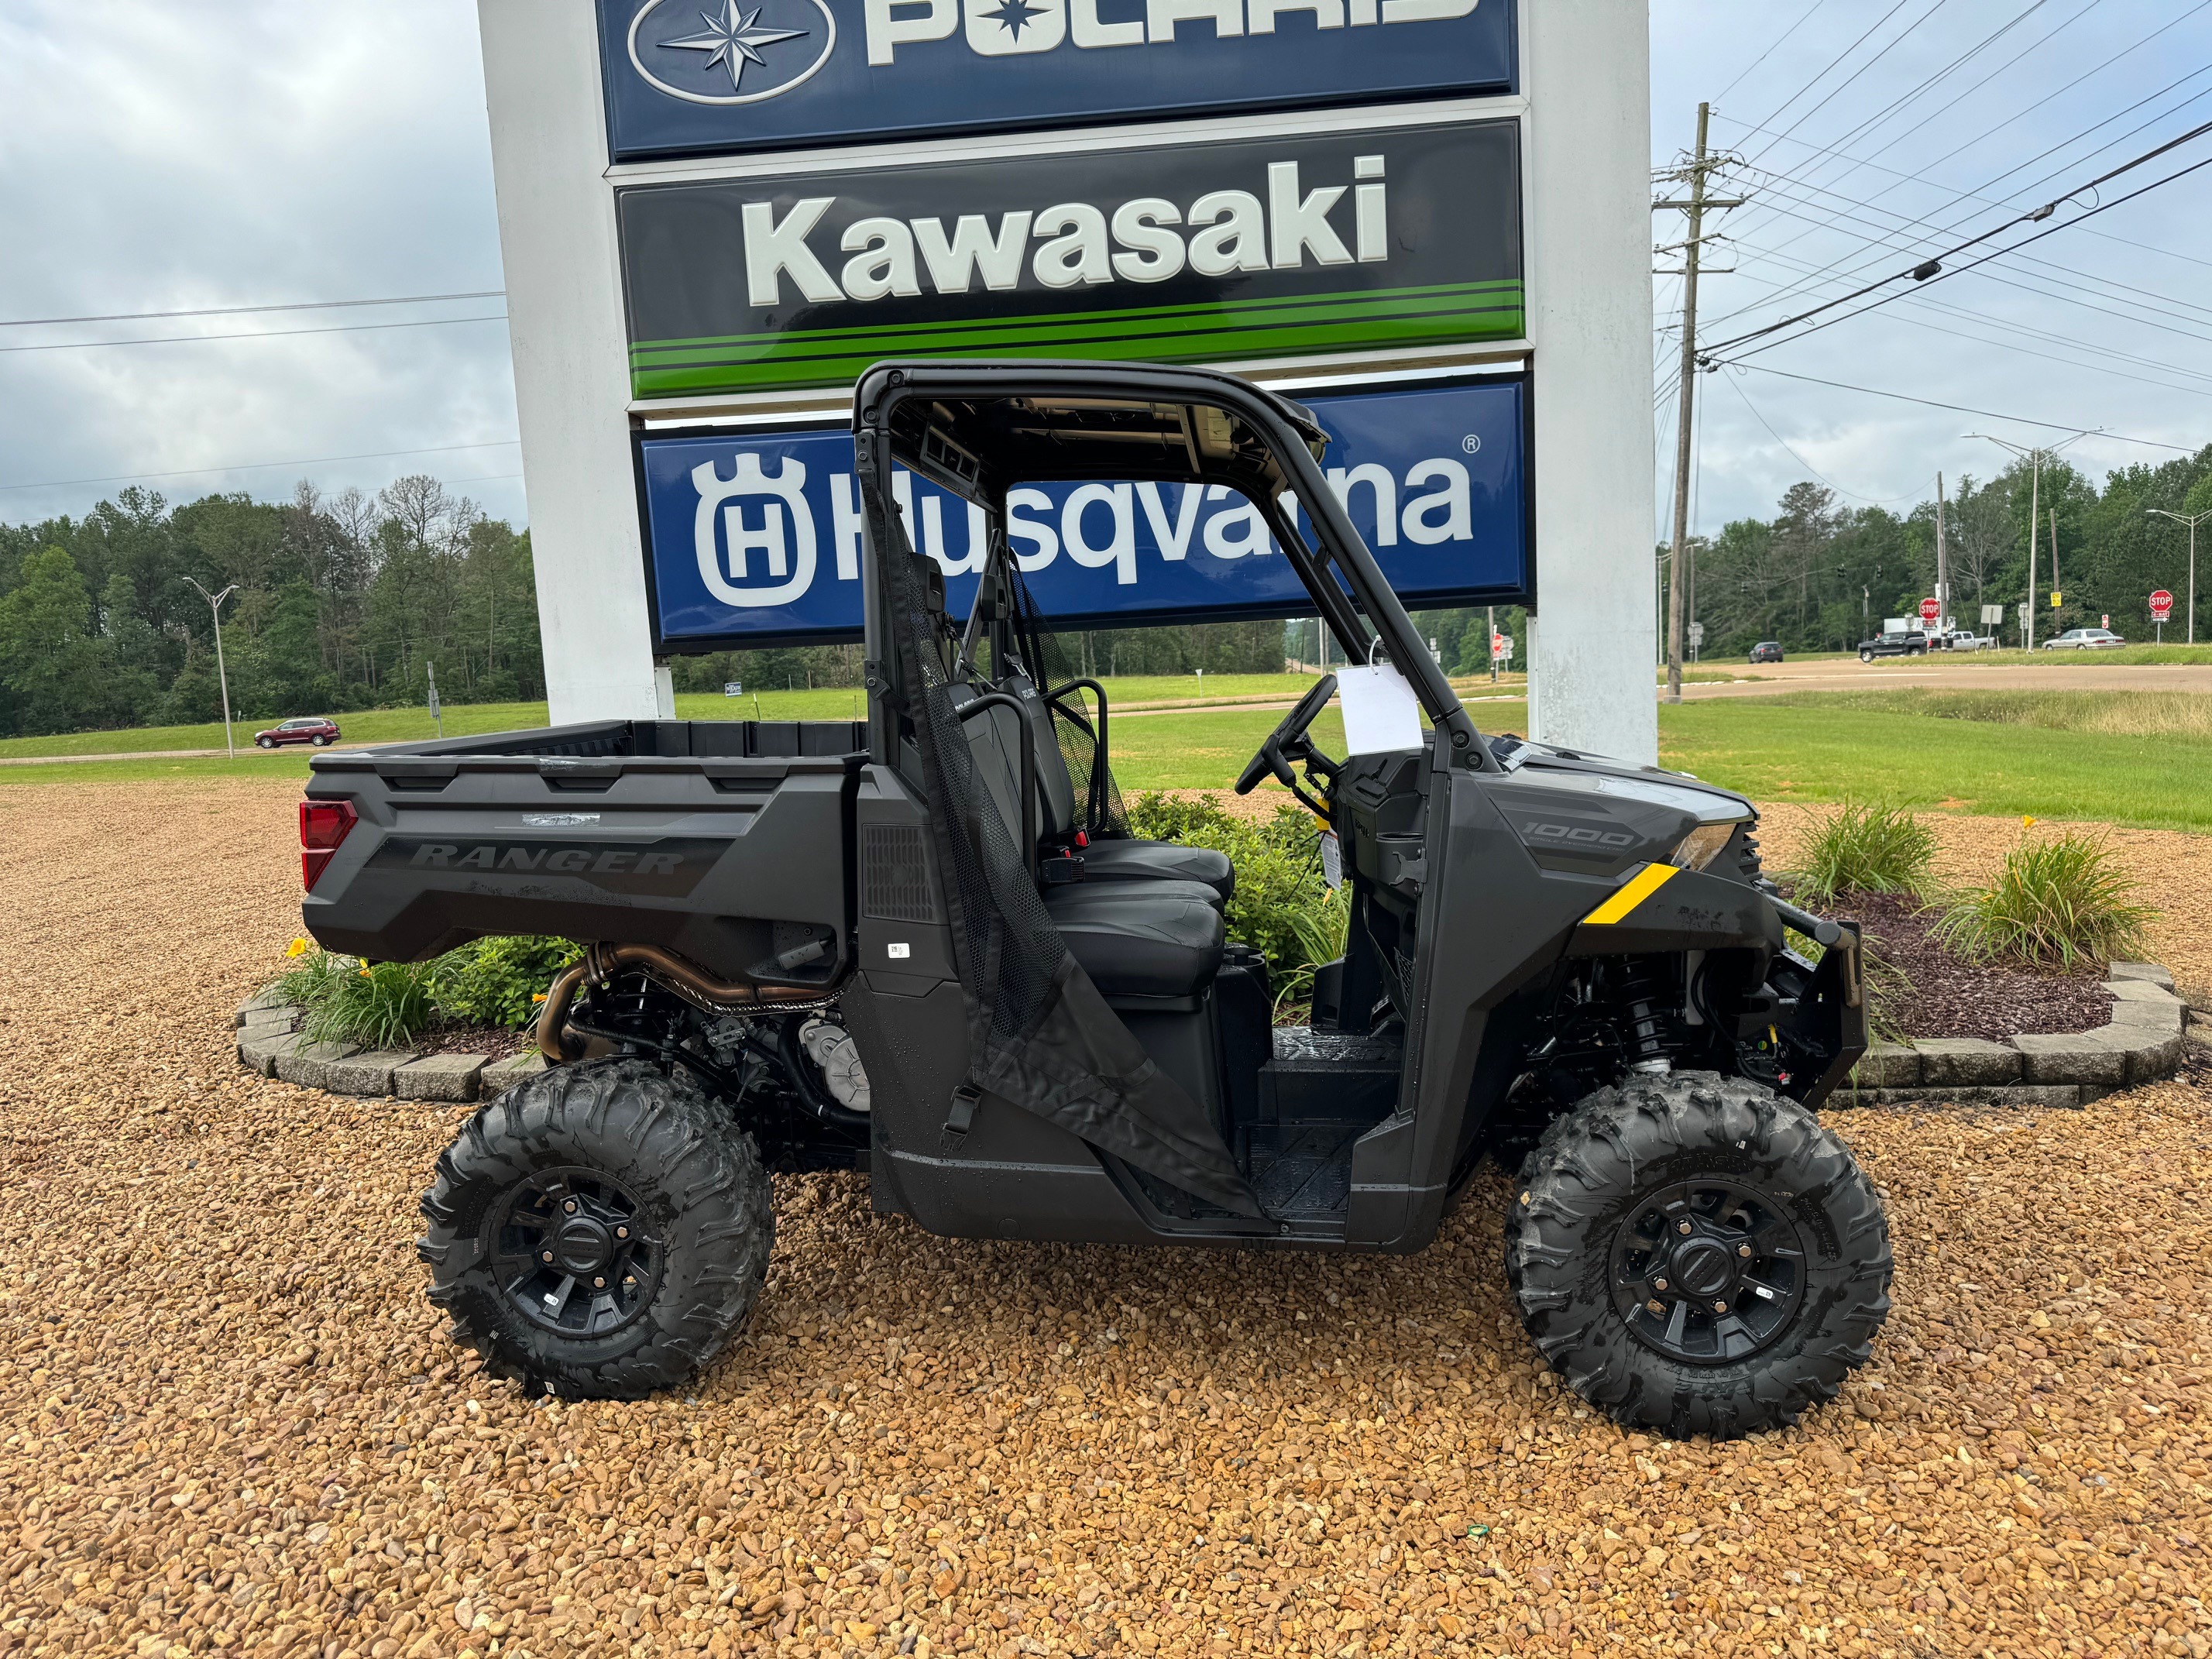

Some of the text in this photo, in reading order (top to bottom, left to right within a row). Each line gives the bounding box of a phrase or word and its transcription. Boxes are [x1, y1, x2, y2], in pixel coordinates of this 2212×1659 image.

[741, 155, 1388, 307] Kawasaki
[1921, 604, 1939, 614] STOP
[2151, 596, 2171, 606] STOP
[1522, 822, 1634, 846] 1000
[407, 843, 685, 874] RANGER
